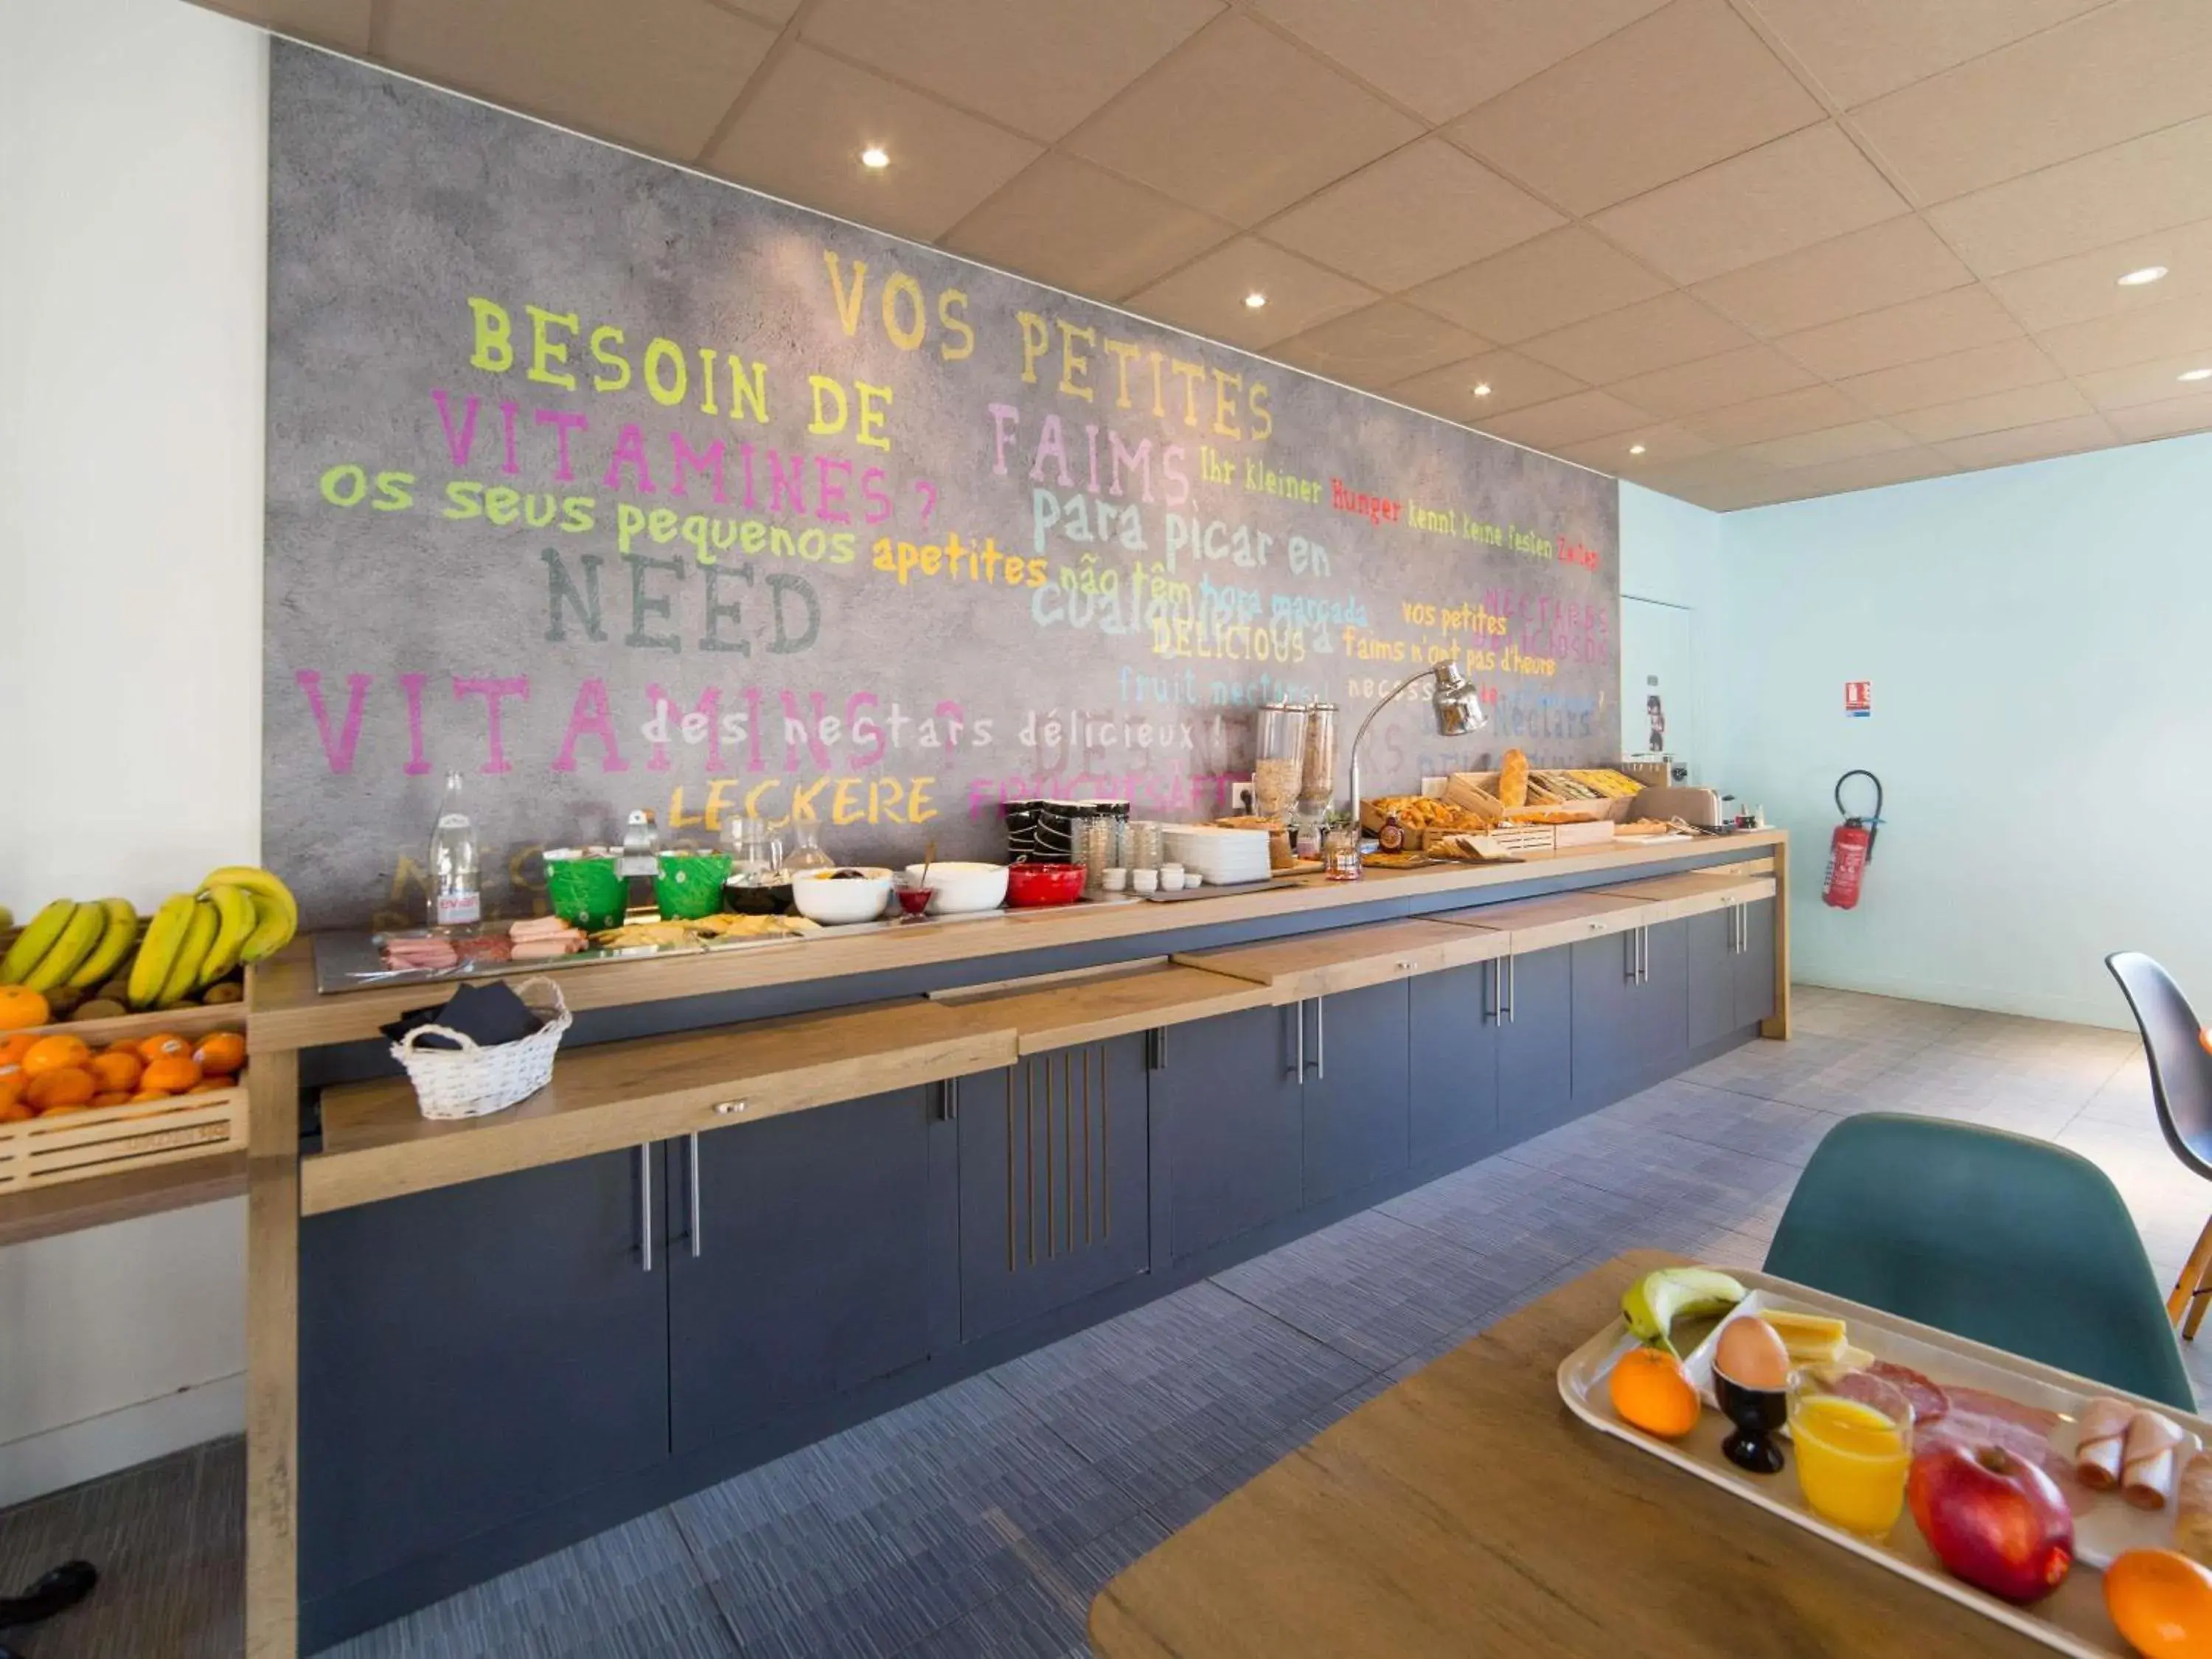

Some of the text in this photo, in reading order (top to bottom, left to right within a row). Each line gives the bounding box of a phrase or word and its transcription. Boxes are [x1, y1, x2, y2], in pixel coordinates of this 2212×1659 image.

[467, 297, 894, 451] BESOIN DE
[823, 249, 1273, 442] VOS PETITES
[431, 389, 937, 529] VITAMINES ?
[988, 403, 1190, 506] FAIMS
[1200, 445, 1236, 486] Ihr
[1245, 455, 1324, 504] kleiner
[1330, 476, 1402, 526] Hunger
[1407, 498, 1456, 538] kennt
[1462, 513, 1503, 547] keine
[444, 480, 596, 532] seus
[617, 503, 856, 566] pequenos
[872, 532, 1048, 588] apetites
[1060, 552, 1118, 596] não
[1131, 560, 1194, 611] têm
[1032, 487, 1332, 577] para picar en
[539, 546, 822, 658] NEED
[1152, 615, 1307, 663] DELICIOUS
[1342, 625, 1405, 662] faims
[1466, 647, 1496, 678] pas
[1402, 600, 1507, 639] vos petites
[294, 669, 886, 776] VITAMINS
[640, 698, 749, 745] des
[784, 702, 994, 749] nectars
[1018, 708, 1195, 751] délicieux
[1118, 664, 1196, 706] fruit
[667, 775, 938, 832] LECKERE
